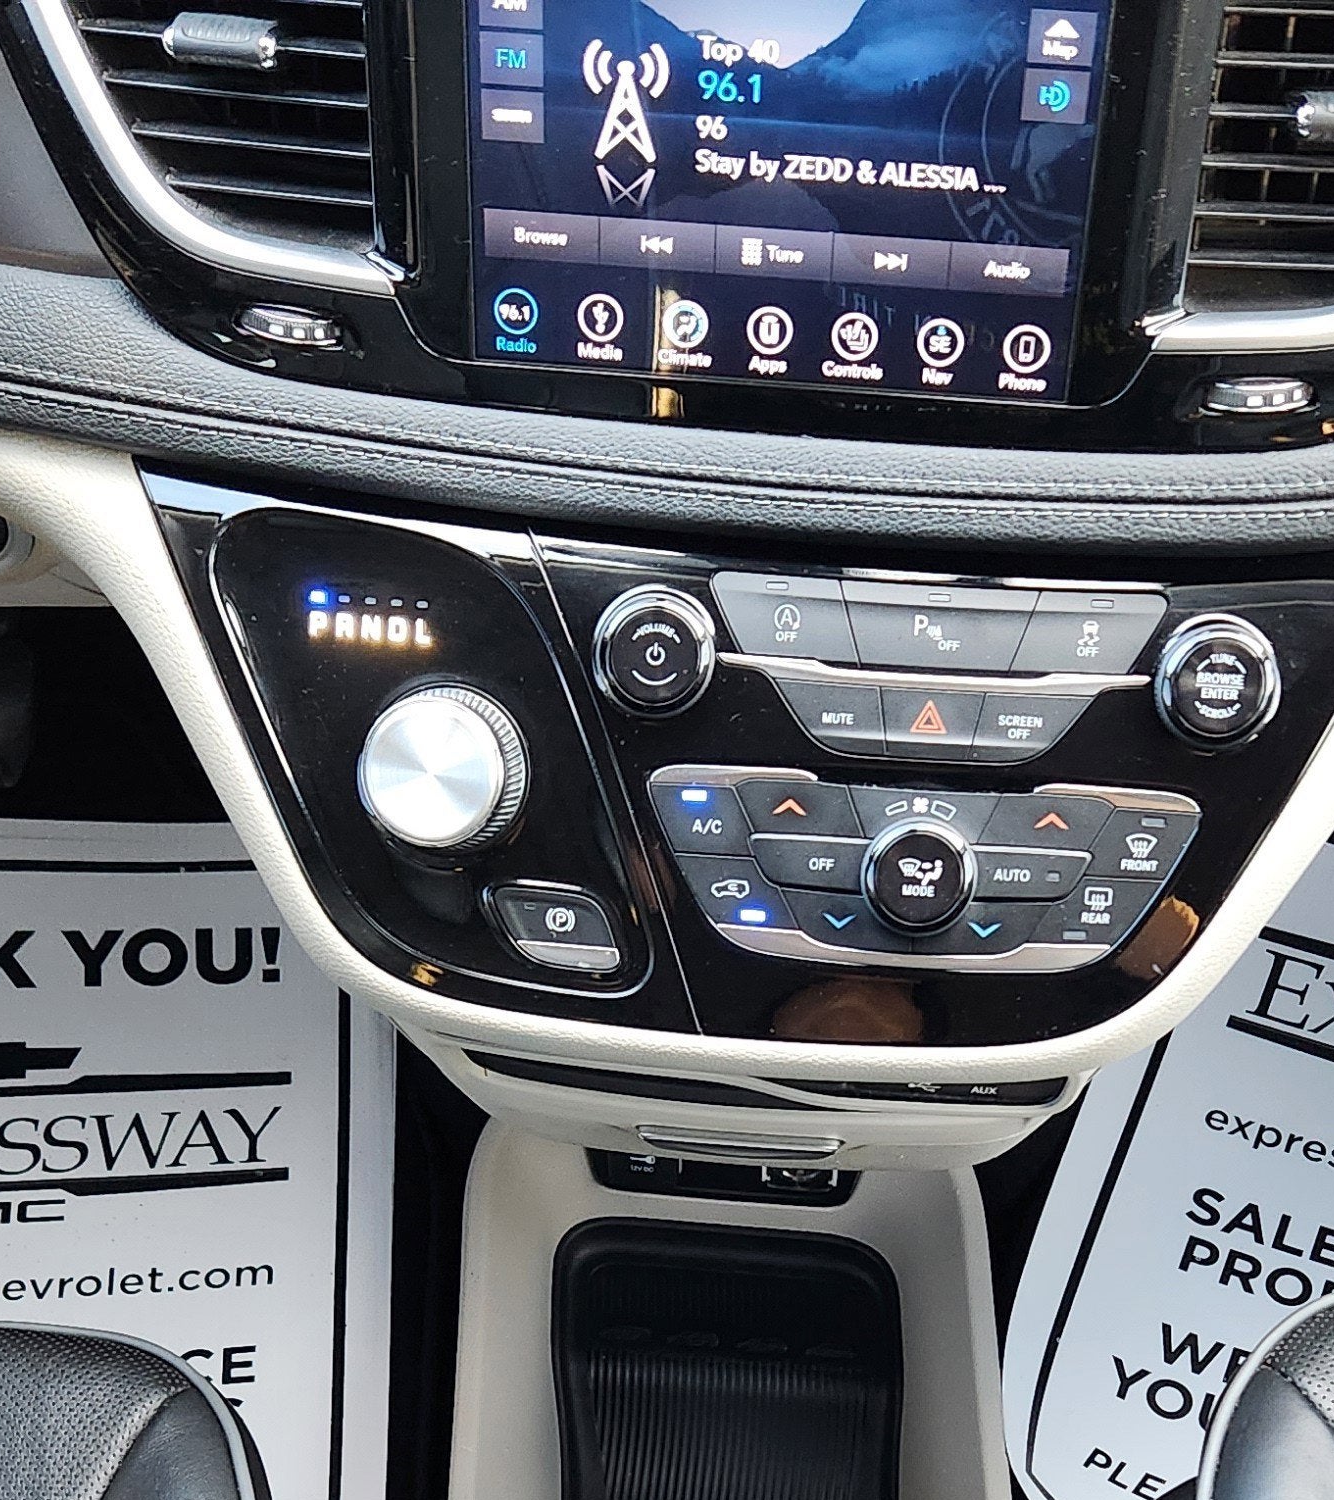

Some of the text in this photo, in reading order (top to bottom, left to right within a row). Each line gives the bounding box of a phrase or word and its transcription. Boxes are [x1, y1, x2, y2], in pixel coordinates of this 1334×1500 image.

[494, 47, 527, 69] FM
[695, 34, 780, 67] Top 40
[1041, 38, 1079, 61] Map
[698, 69, 762, 104] 96.1
[696, 115, 728, 140] 96
[695, 148, 745, 181] Stay
[750, 150, 781, 183] by
[783, 154, 853, 182] ZEDD
[856, 159, 877, 184] &
[879, 161, 980, 191] ALESSIA
[514, 226, 568, 247] Browse
[766, 245, 804, 265] Tune
[983, 260, 1031, 280] Audio
[496, 337, 537, 354] Radio
[577, 342, 623, 362] Media
[657, 347, 712, 369] Climate
[748, 355, 788, 376] Apps
[821, 361, 883, 382] Controls
[921, 367, 954, 386] Nav
[997, 373, 1047, 393] Phone
[636, 622, 675, 638] VOLUME
[775, 631, 798, 643] OFF
[937, 639, 961, 652] OFF
[1076, 645, 1100, 658] OFF
[1210, 652, 1237, 666] TUNE
[1196, 671, 1245, 686] BROWSE
[1200, 686, 1240, 701] ENTER
[822, 711, 854, 726] MUTE
[1198, 703, 1237, 719] SCROLL
[998, 714, 1043, 729] SCREEN
[1007, 727, 1031, 740] OFF
[691, 818, 723, 835] A/C
[809, 856, 835, 873] OFF
[1120, 857, 1159, 873] FRONT
[993, 868, 1031, 883] AUTO
[901, 884, 936, 898] MODE
[1080, 911, 1111, 925] REAR
[61, 926, 281, 988] YOU!
[970, 1085, 999, 1096] AUX
